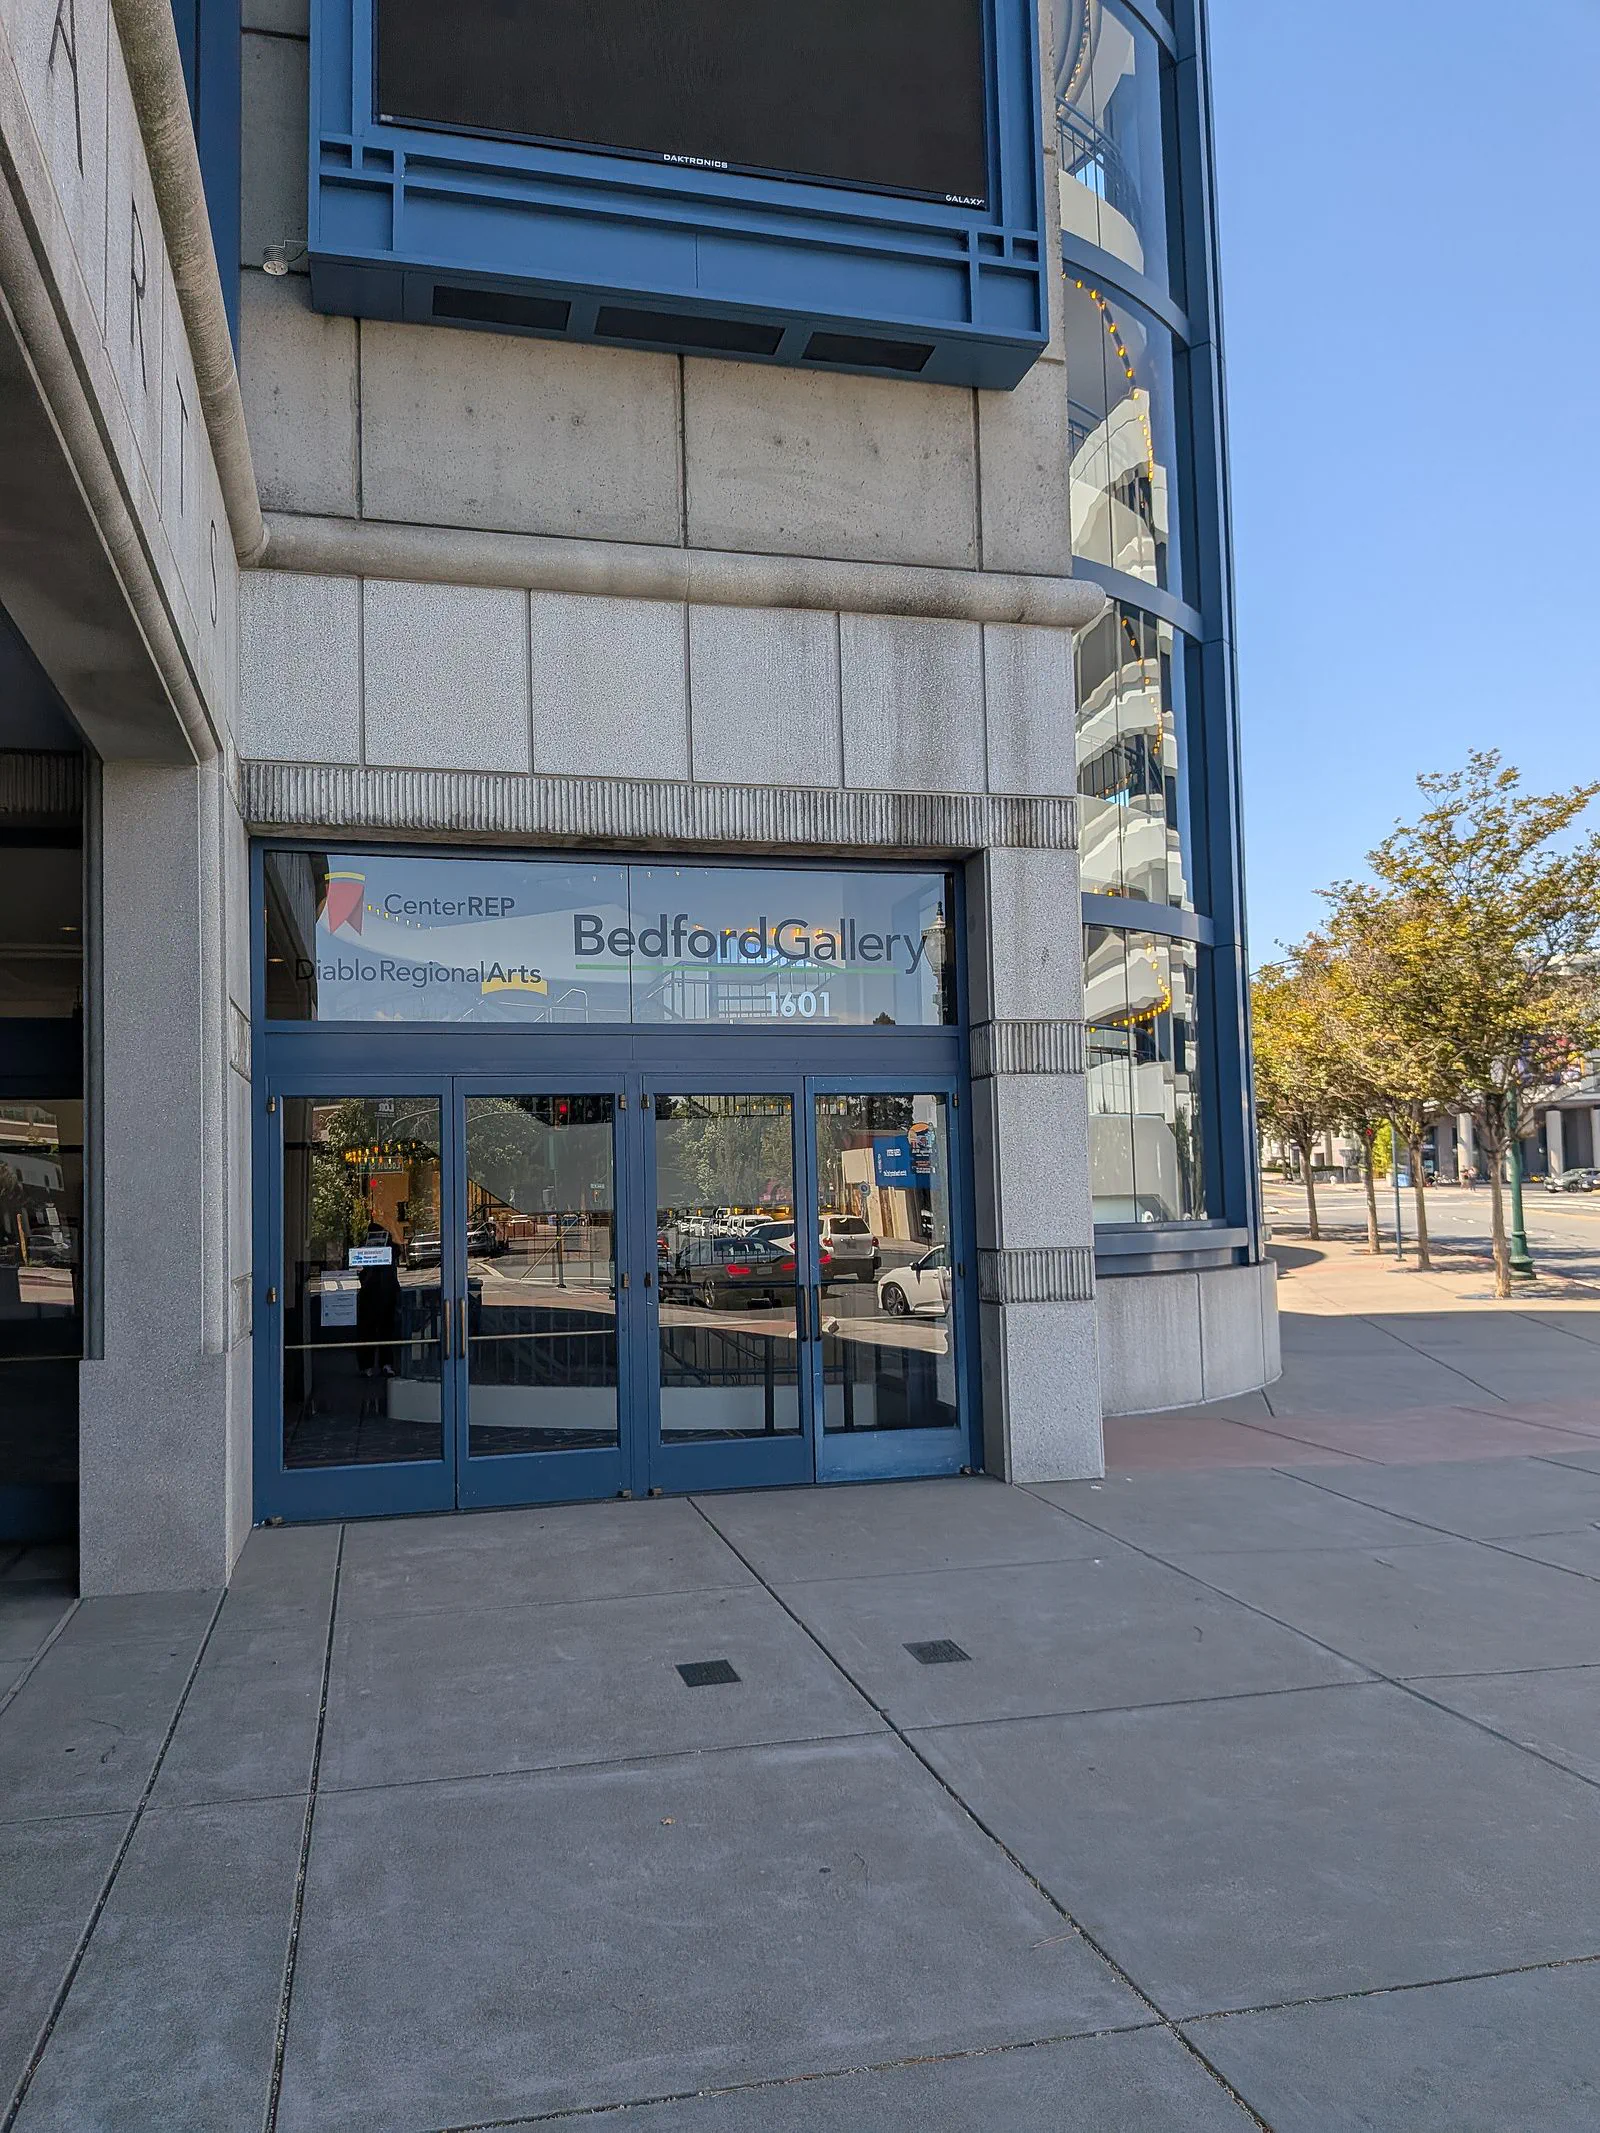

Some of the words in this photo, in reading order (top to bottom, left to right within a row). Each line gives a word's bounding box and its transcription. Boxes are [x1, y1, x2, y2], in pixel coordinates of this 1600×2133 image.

[663, 153, 728, 169] DAKTRONICS
[945, 194, 983, 206] GALAXY
[383, 893, 515, 918] CenterREP
[573, 912, 926, 975] BedfordGallery
[295, 958, 542, 988] DiabloRegionalArts
[766, 991, 831, 1018] 1601
